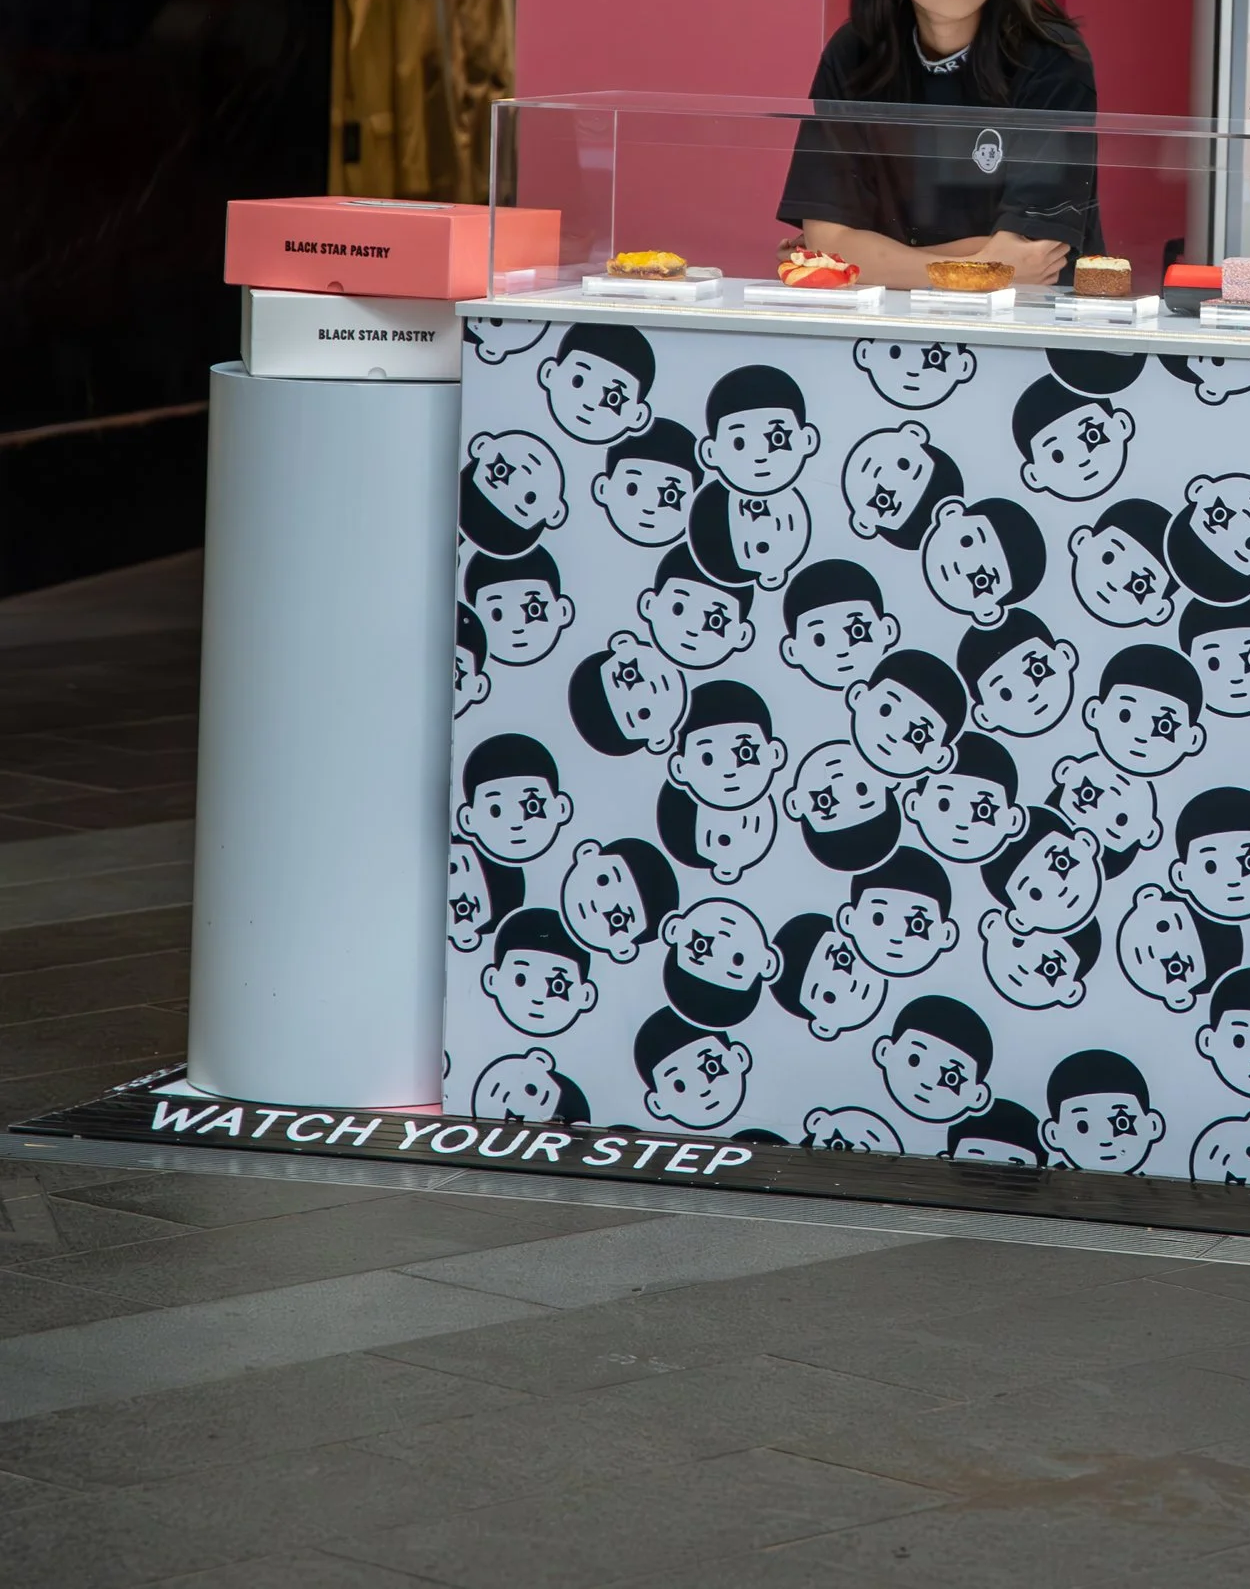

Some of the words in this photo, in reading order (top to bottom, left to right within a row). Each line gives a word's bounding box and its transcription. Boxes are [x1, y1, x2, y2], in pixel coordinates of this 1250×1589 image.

[285, 240, 318, 254] BLACK
[320, 243, 347, 256] STAR
[350, 245, 390, 259] PASTRY
[318, 329, 355, 341] BLACK
[358, 329, 387, 341] STAR
[391, 330, 435, 342] PASTRY
[152, 1101, 383, 1146] WATCH
[398, 1120, 572, 1162] YOUR
[582, 1137, 752, 1175] STEP
